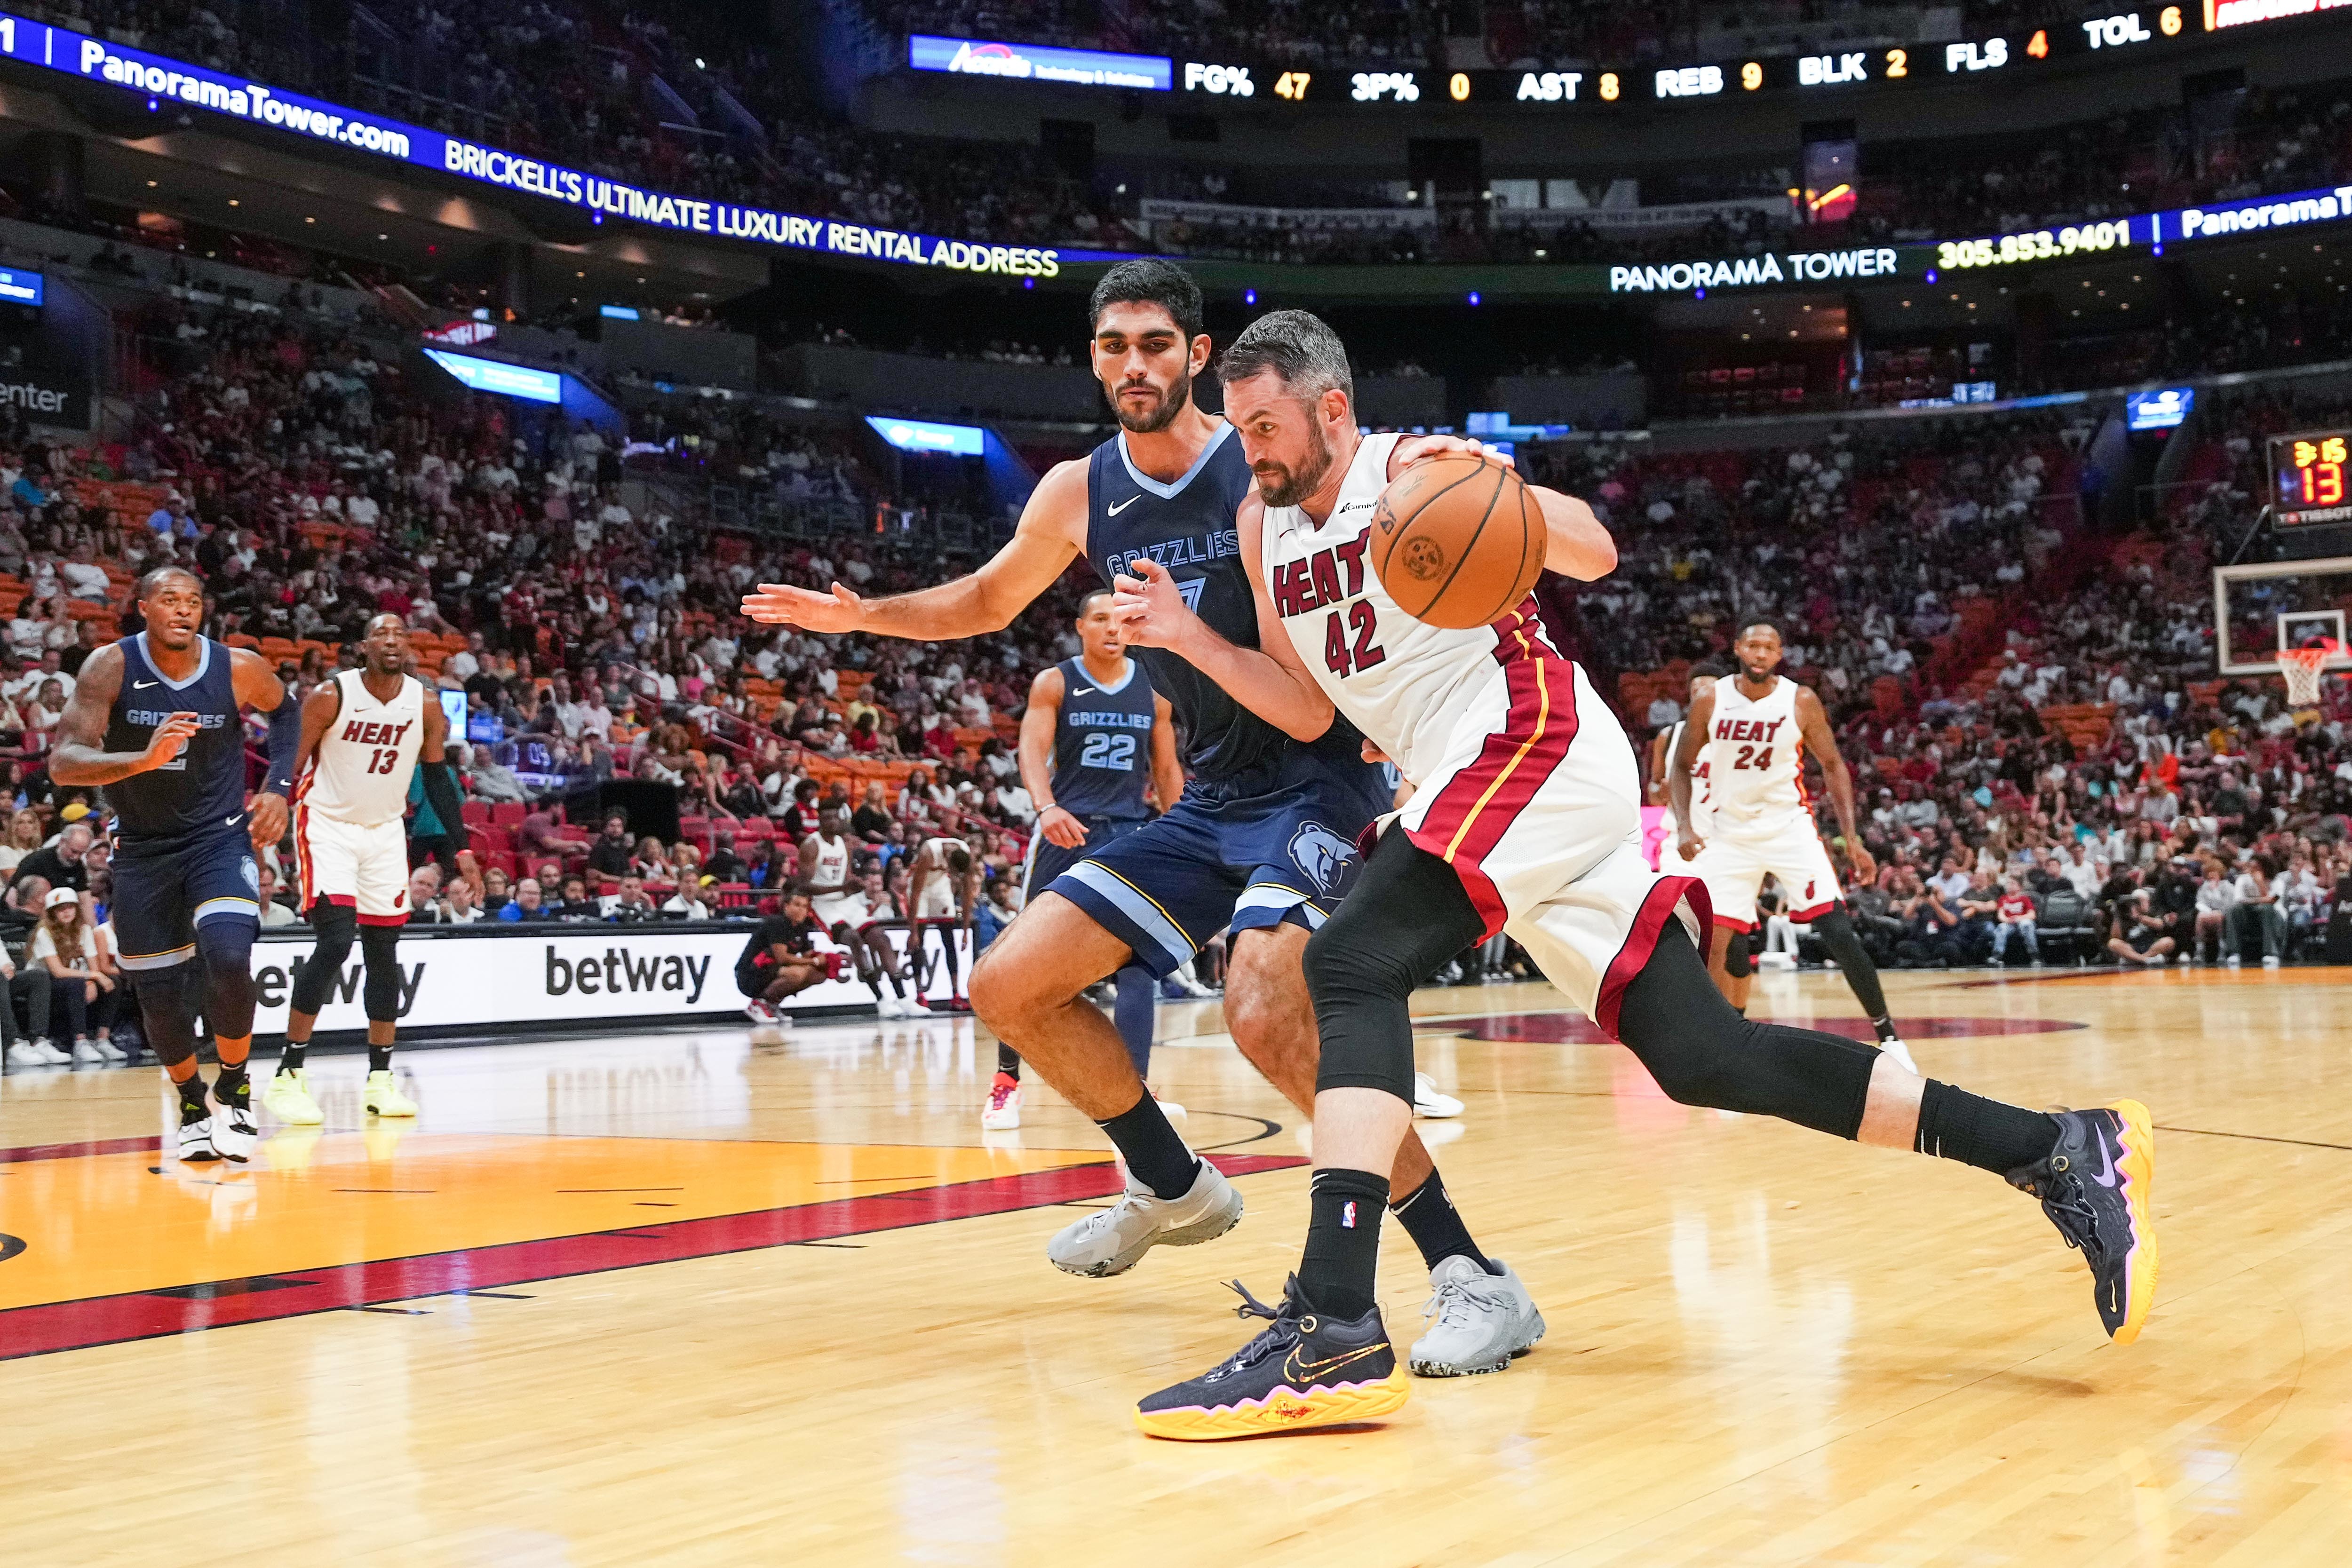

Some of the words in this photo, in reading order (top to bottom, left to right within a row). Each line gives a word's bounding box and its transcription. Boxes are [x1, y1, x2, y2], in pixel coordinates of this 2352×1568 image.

[2082, 13, 2151, 49] TOL
[2160, 6, 2183, 36] 6
[1798, 52, 1867, 86] BLK
[1886, 48, 1908, 78] 2
[1946, 37, 2008, 72] FLS
[2026, 30, 2049, 59] 4
[80, 40, 410, 158] PanoramaTower.com
[1184, 62, 1255, 97] FG%
[1274, 71, 1311, 101] 47
[1351, 72, 1420, 102] 3P%
[1449, 72, 1470, 101] 0
[1516, 72, 1583, 101] AST
[1599, 72, 1620, 101] 8
[1655, 65, 1724, 98] REB
[1741, 62, 1763, 91] 9
[444, 139, 582, 203] BRICKELL'S
[586, 177, 712, 231] ULTIMATE
[717, 206, 823, 247] LUXURY
[828, 223, 929, 265] RENTAL
[930, 239, 1059, 277] ADDRESS
[1938, 219, 2131, 270] 305.853.9401
[1610, 252, 1784, 292] PANORAMA
[1787, 248, 1897, 280] TOWER
[2302, 462, 2344, 505] 13
[1347, 499, 1378, 510] Carnival
[1273, 526, 1370, 618] HEAT
[1325, 599, 1386, 679] 42
[126, 709, 226, 729] GRIZIES
[341, 718, 413, 746] HEAT
[1068, 711, 1152, 729] GRIZZLIES
[1715, 715, 1787, 743] HEAT
[367, 748, 399, 775] 13
[1081, 732, 1136, 772] 22
[1733, 745, 1774, 771] 24
[546, 945, 711, 1004] betway
